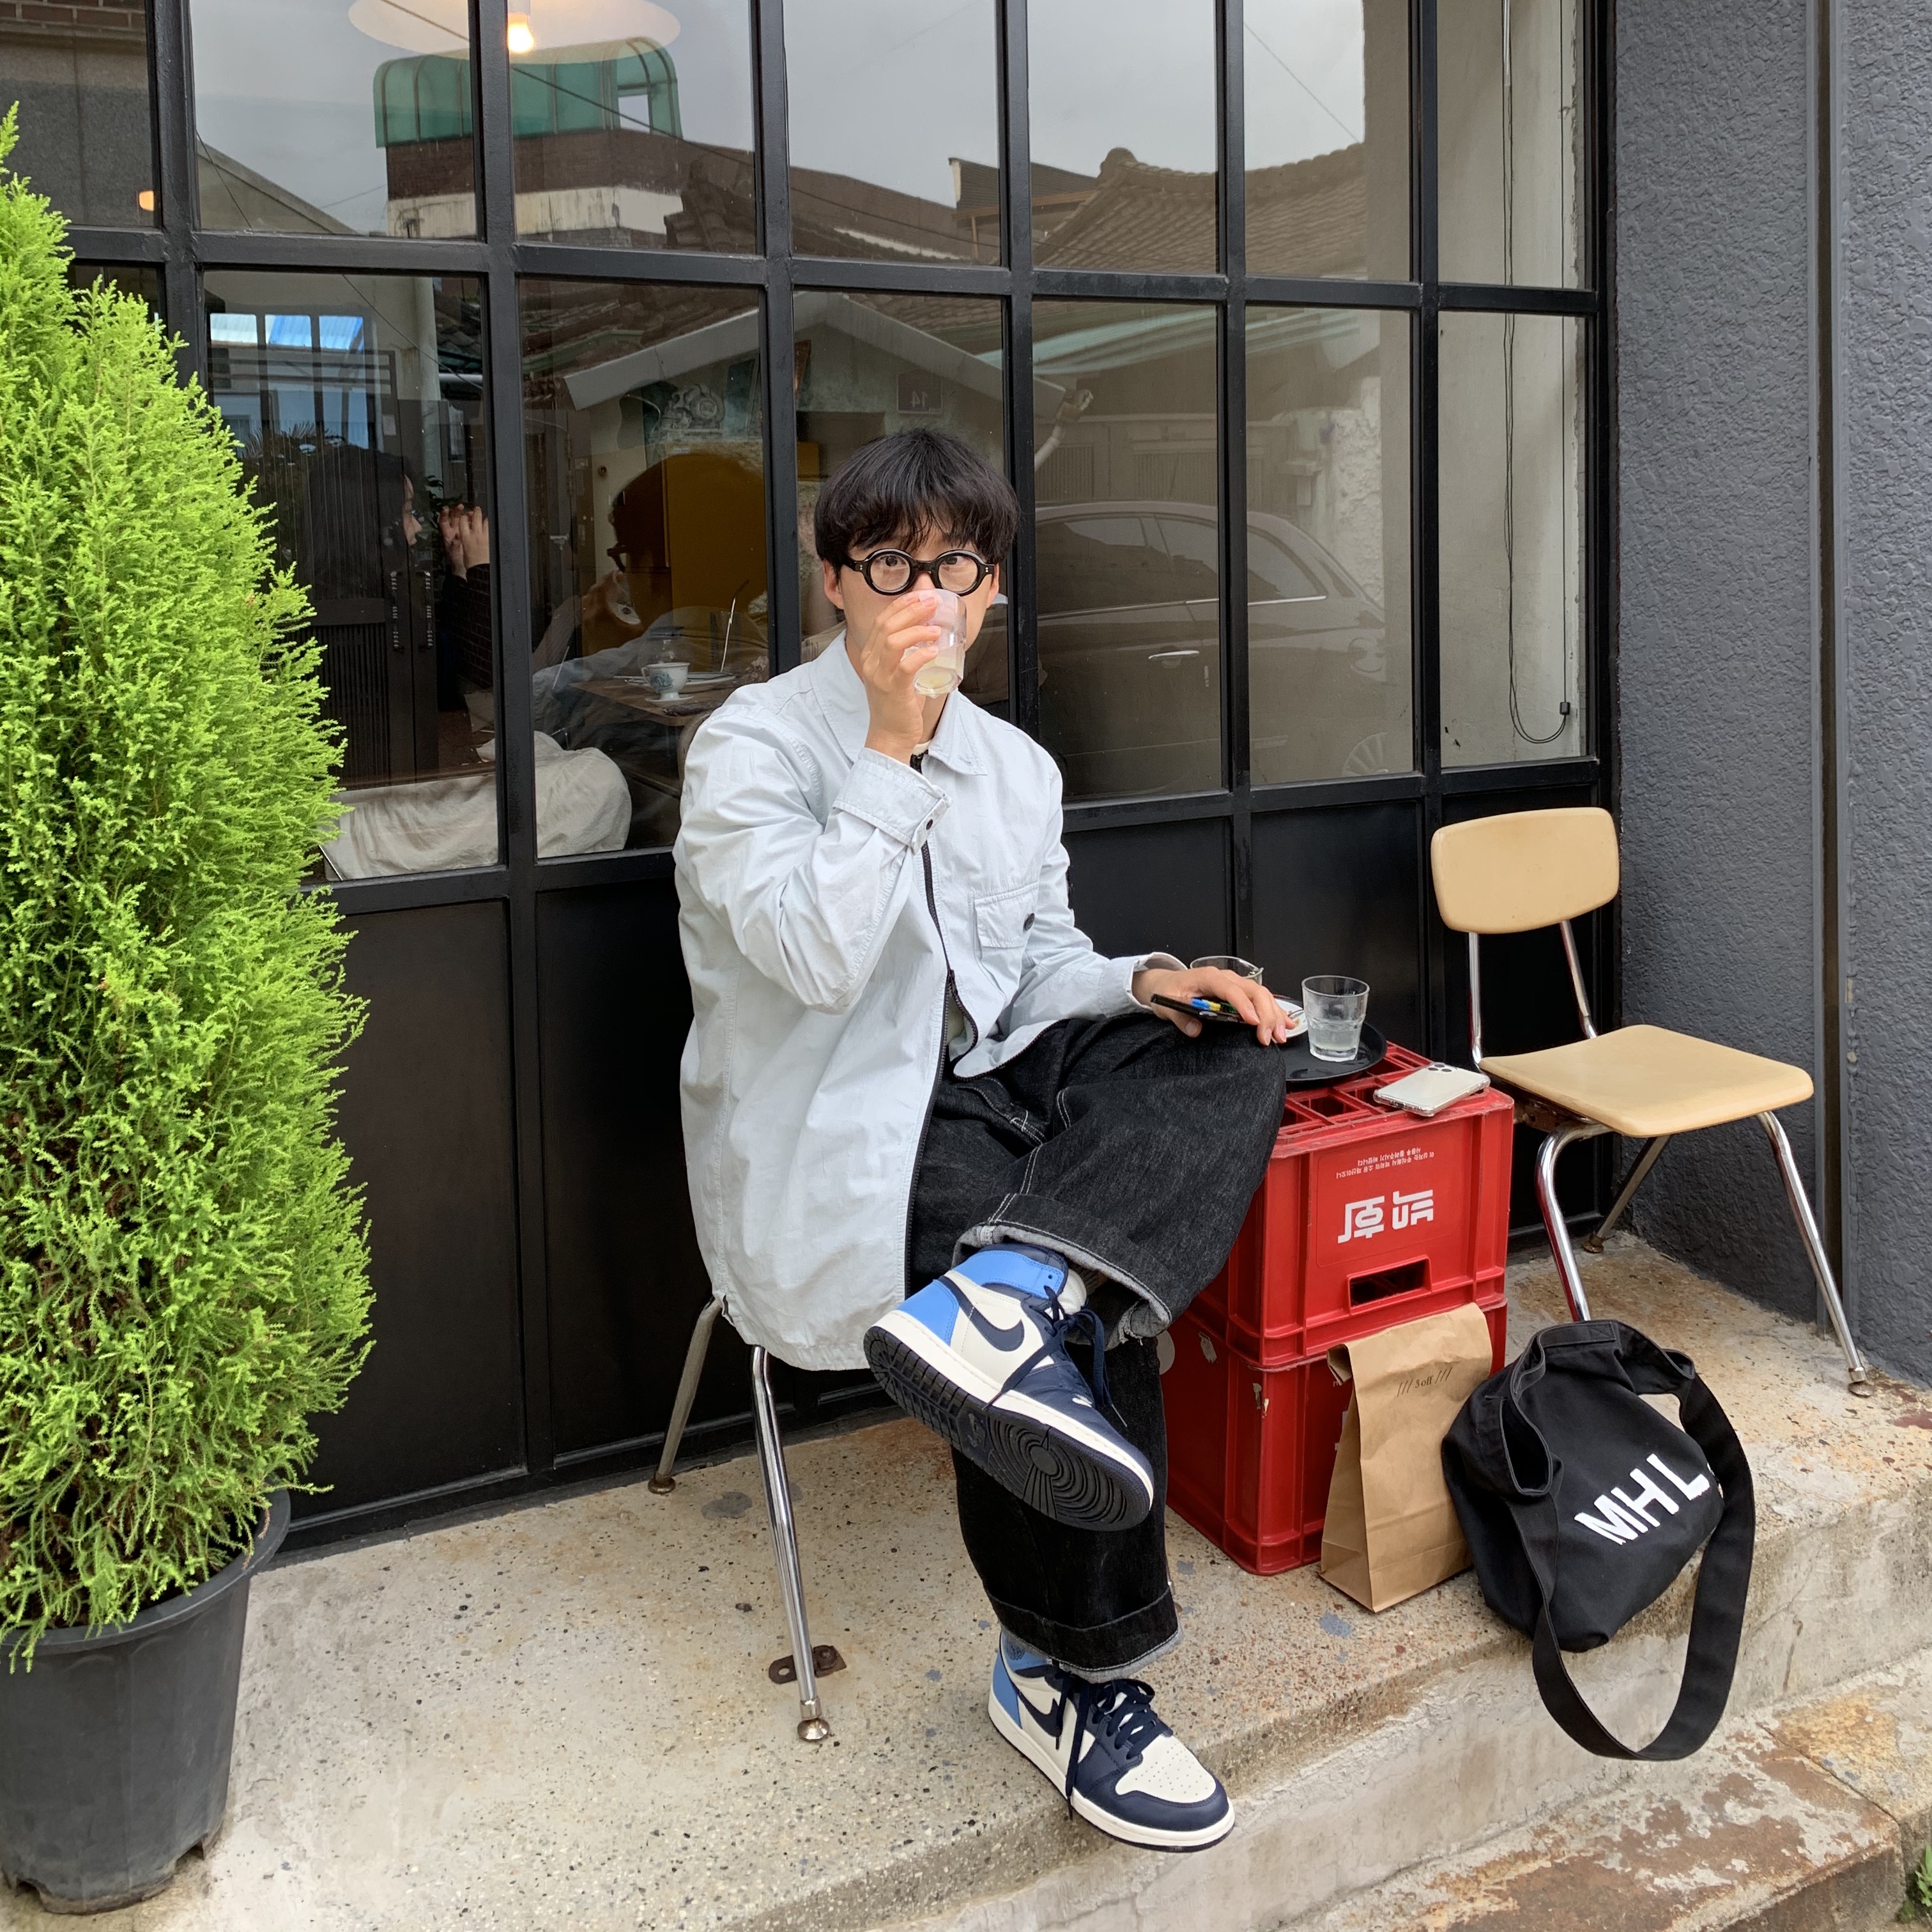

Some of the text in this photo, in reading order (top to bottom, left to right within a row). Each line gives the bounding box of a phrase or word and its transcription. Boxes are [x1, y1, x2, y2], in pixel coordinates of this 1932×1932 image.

[1358, 1147, 1422, 1167] 사용후 돌려주시기 바랍니다
[1392, 1156, 1411, 1165] 주식회사
[1413, 1152, 1428, 1160] 상자는
[1336, 1168, 1361, 1179] 재산이오니
